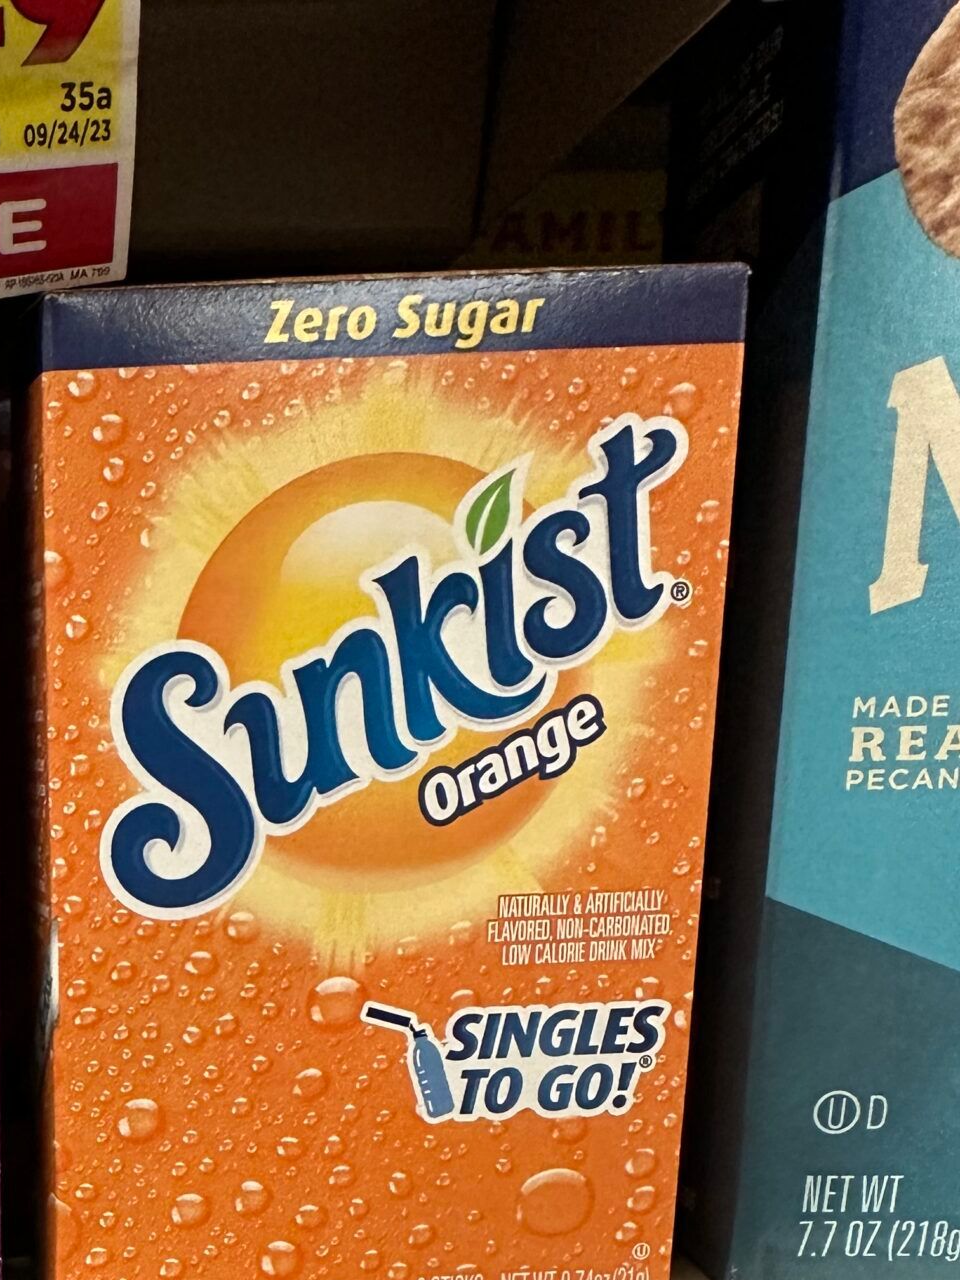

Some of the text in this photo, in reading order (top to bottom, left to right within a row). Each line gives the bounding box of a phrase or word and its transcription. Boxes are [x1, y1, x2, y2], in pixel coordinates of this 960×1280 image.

[60, 81, 112, 112] 35a
[23, 119, 111, 148] 09/24/23
[263, 295, 545, 350] Zero Sugar
[100, 411, 690, 920] Sunkist
[852, 695, 950, 718] MADE
[421, 696, 606, 825] Orange
[445, 1006, 664, 1061] SINGLES
[459, 1062, 637, 1115] TO GO!
[802, 1175, 903, 1214] NET WT
[796, 1221, 837, 1258] 7.7
[843, 1221, 883, 1257] OZ
